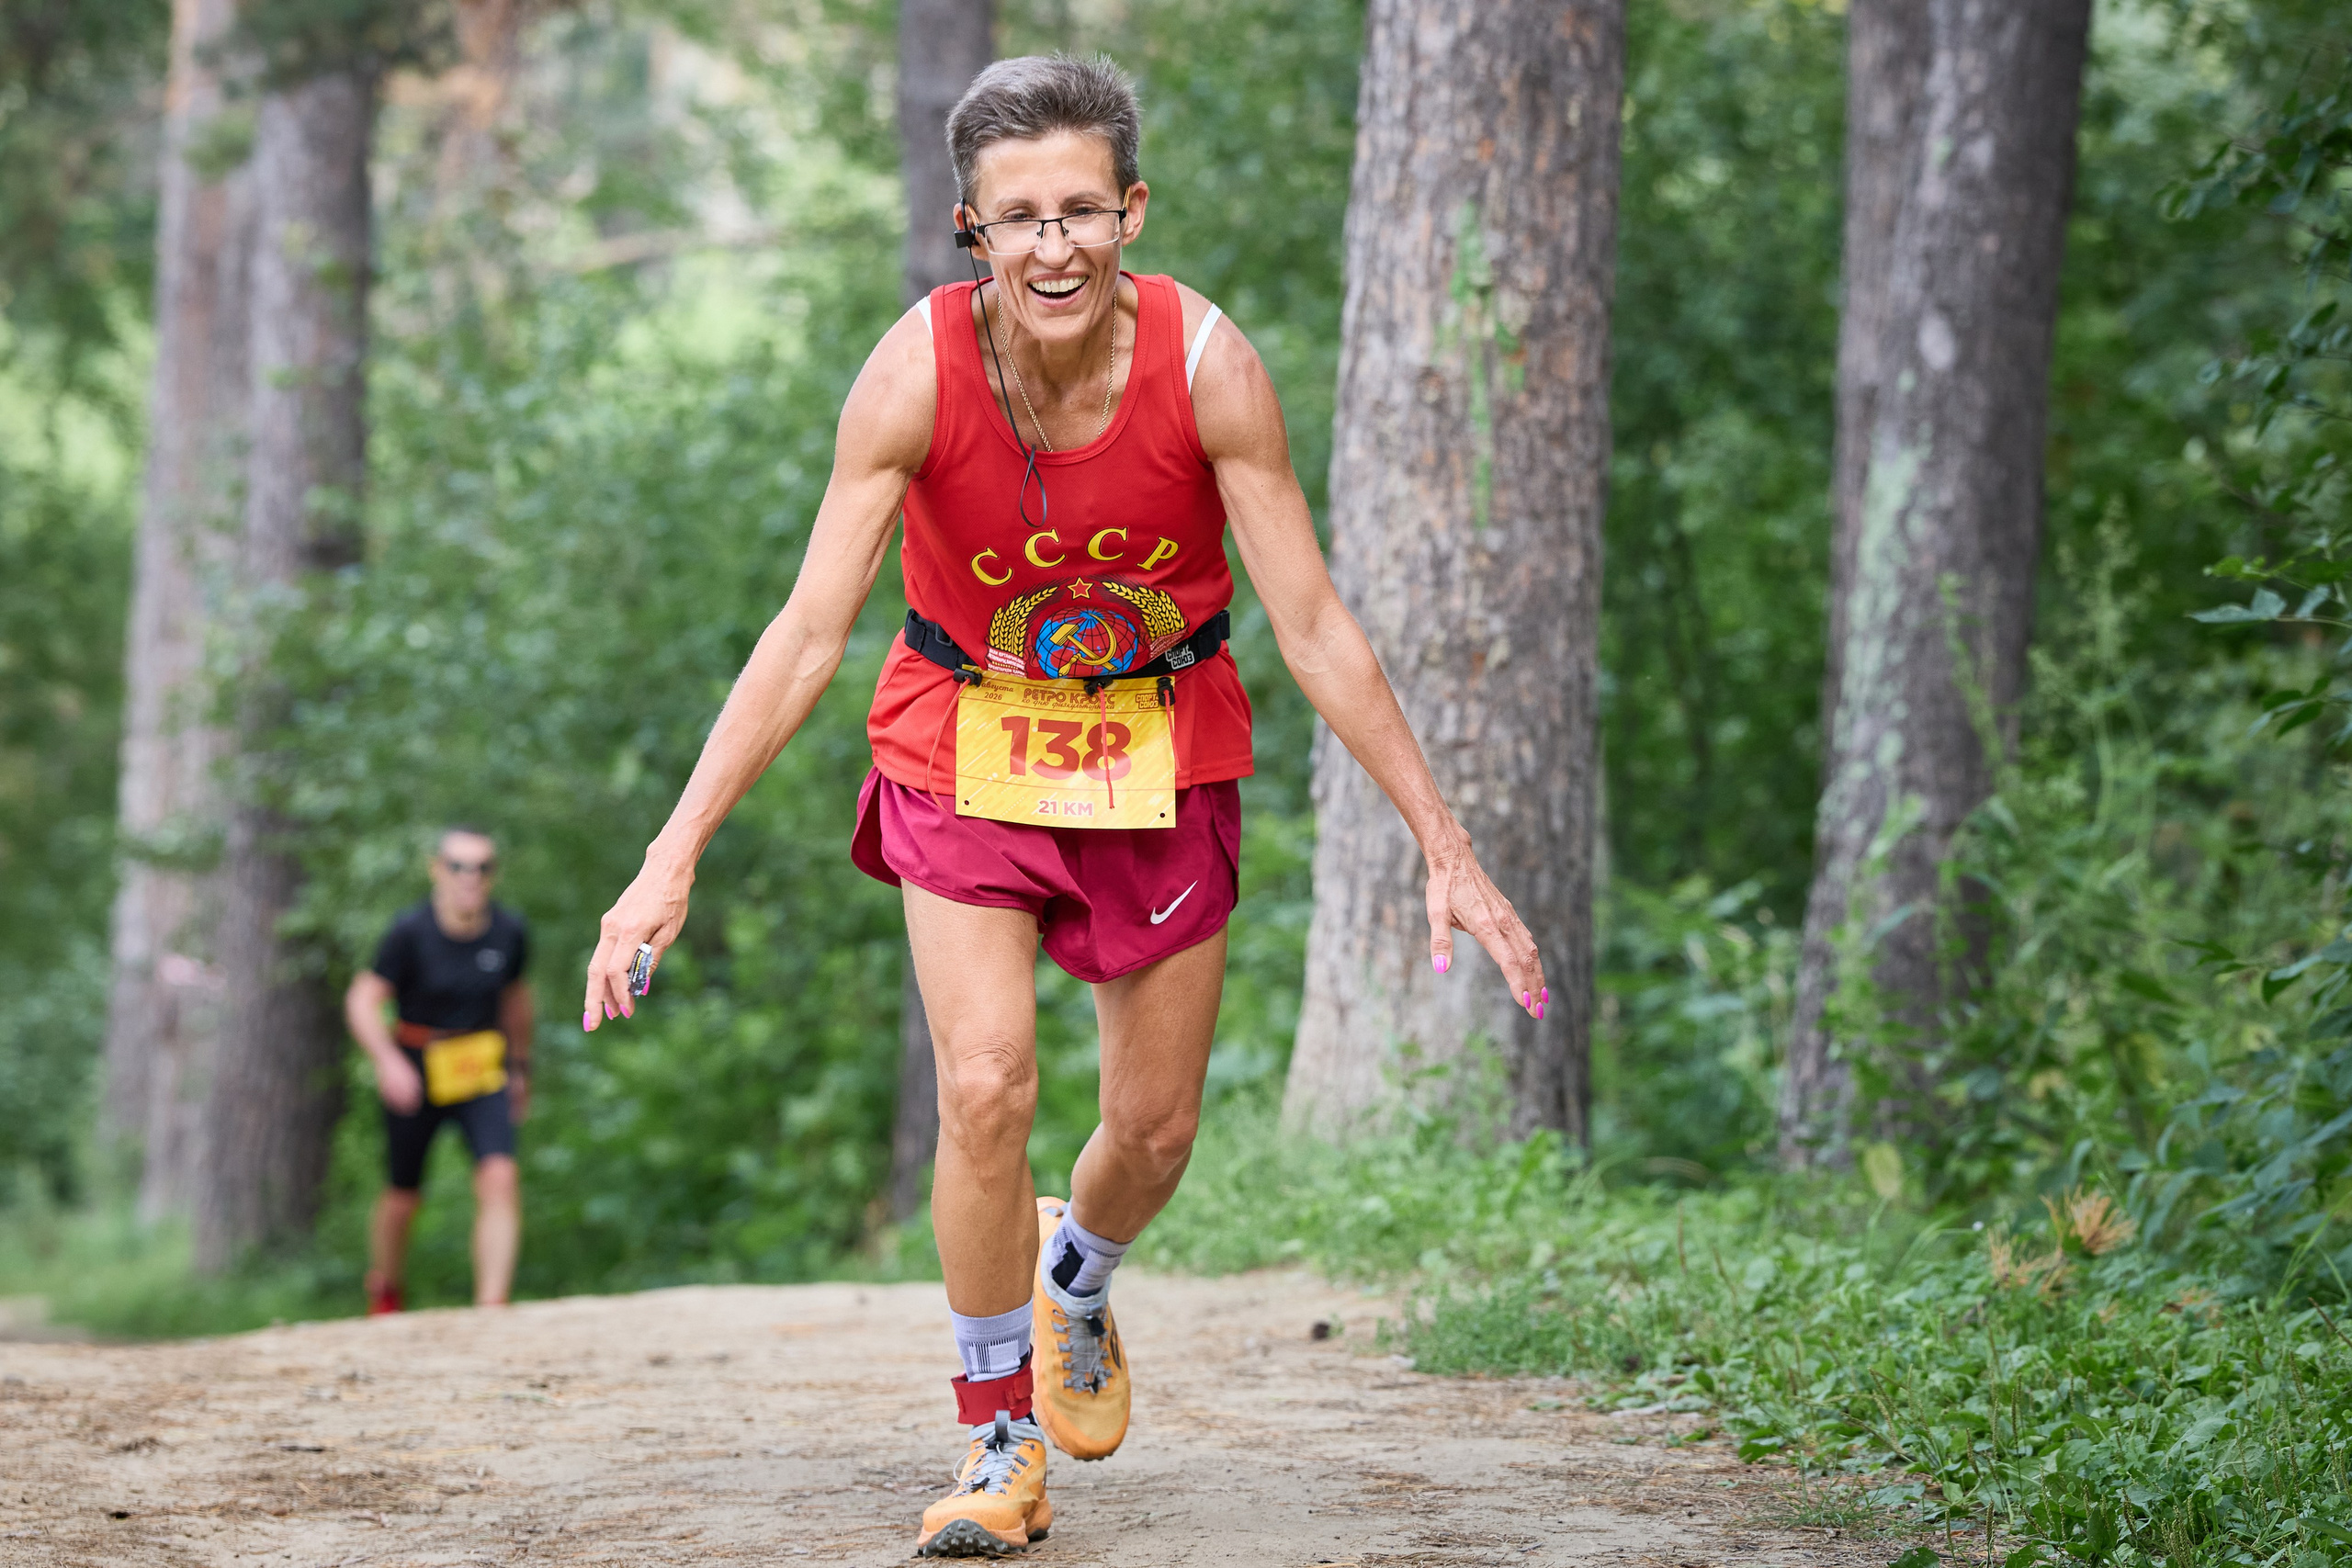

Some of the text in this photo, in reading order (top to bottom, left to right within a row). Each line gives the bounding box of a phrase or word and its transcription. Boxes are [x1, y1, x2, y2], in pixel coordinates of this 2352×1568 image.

[970, 527, 1179, 586] СССР
[1172, 653, 1193, 668] СОЮЗ
[981, 682, 1014, 693] августа
[984, 692, 1002, 700] 2026
[1023, 688, 1066, 703] РЕТРО
[1136, 694, 1157, 702] СПОРТ
[1052, 702, 1114, 711] физкультурнка
[1139, 700, 1159, 708] СОЮЗ
[1001, 716, 1132, 782] 138
[1038, 800, 1092, 816] 21 КМ
